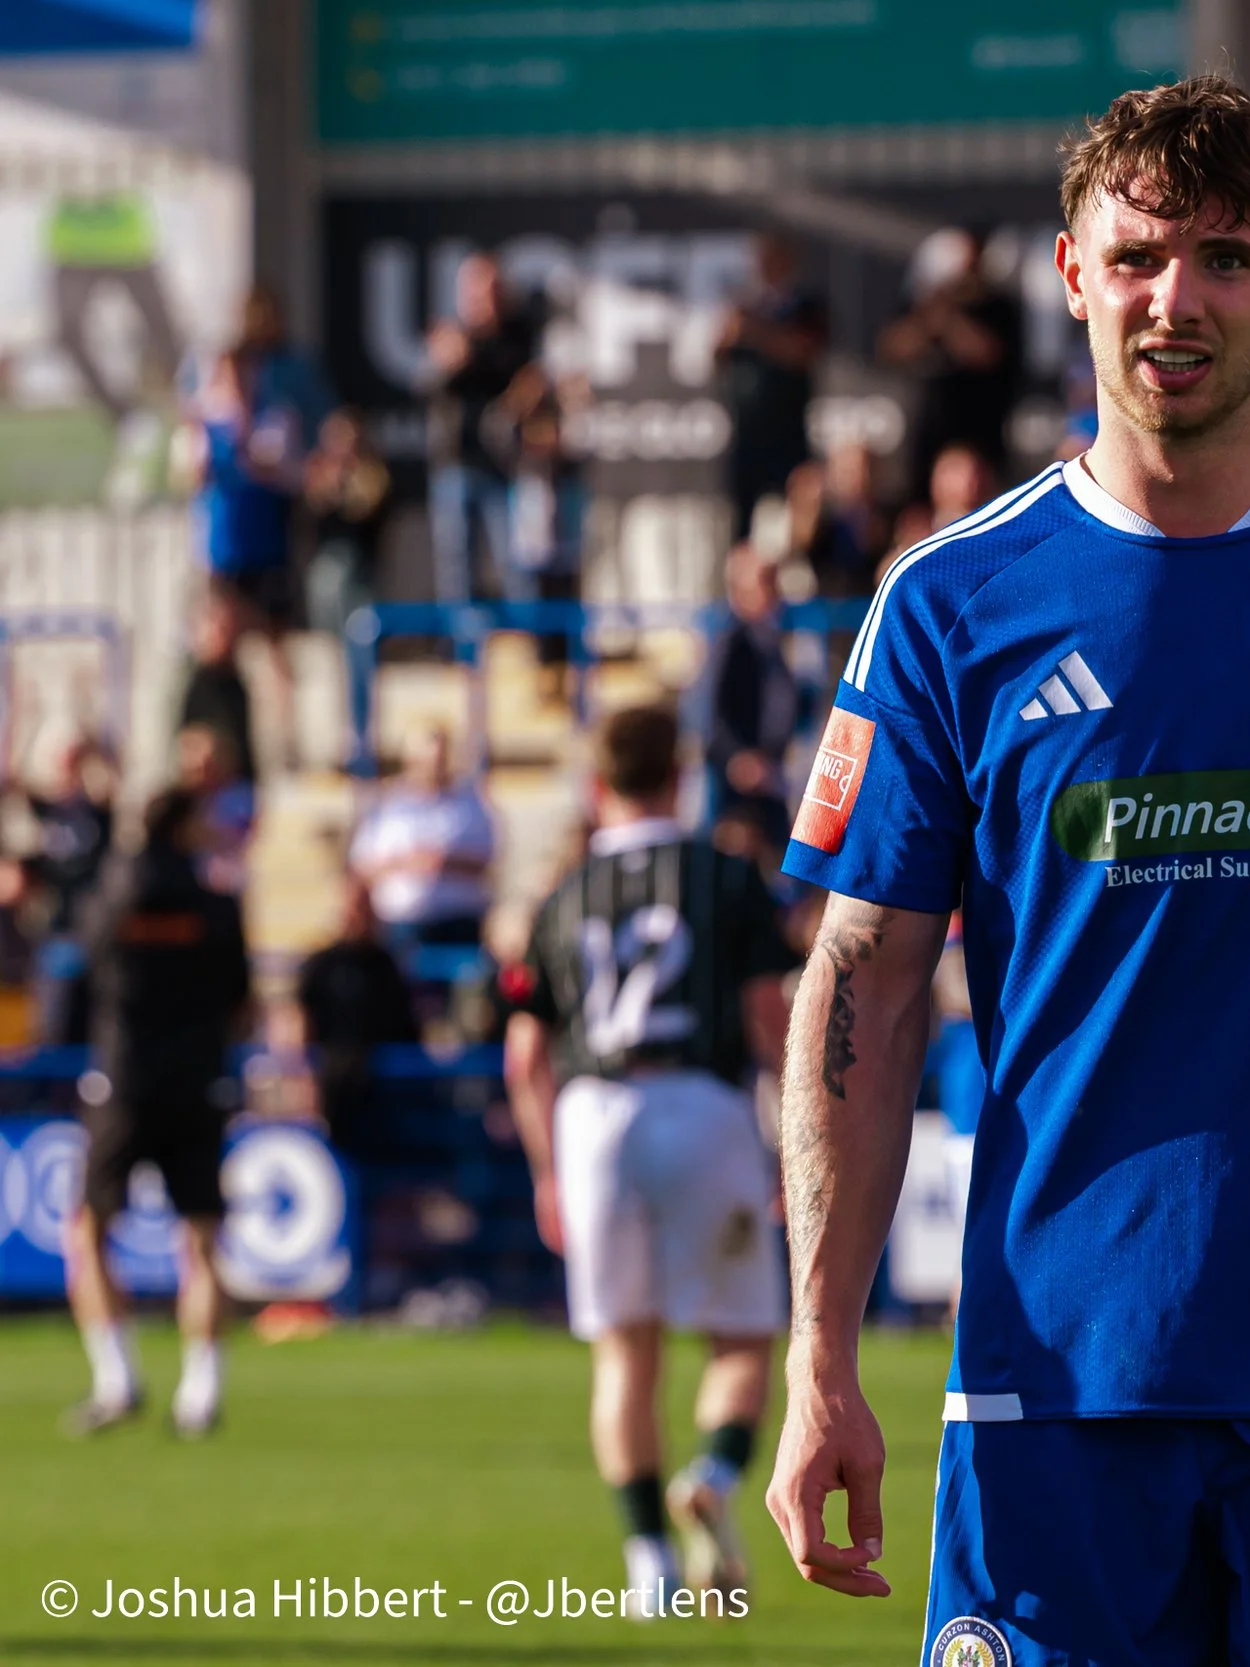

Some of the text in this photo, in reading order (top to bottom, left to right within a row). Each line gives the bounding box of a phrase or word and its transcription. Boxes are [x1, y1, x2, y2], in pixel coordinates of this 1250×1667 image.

[1105, 857, 1213, 887] Electrical
[938, 1623, 1006, 1661] CURZON ASHTON
